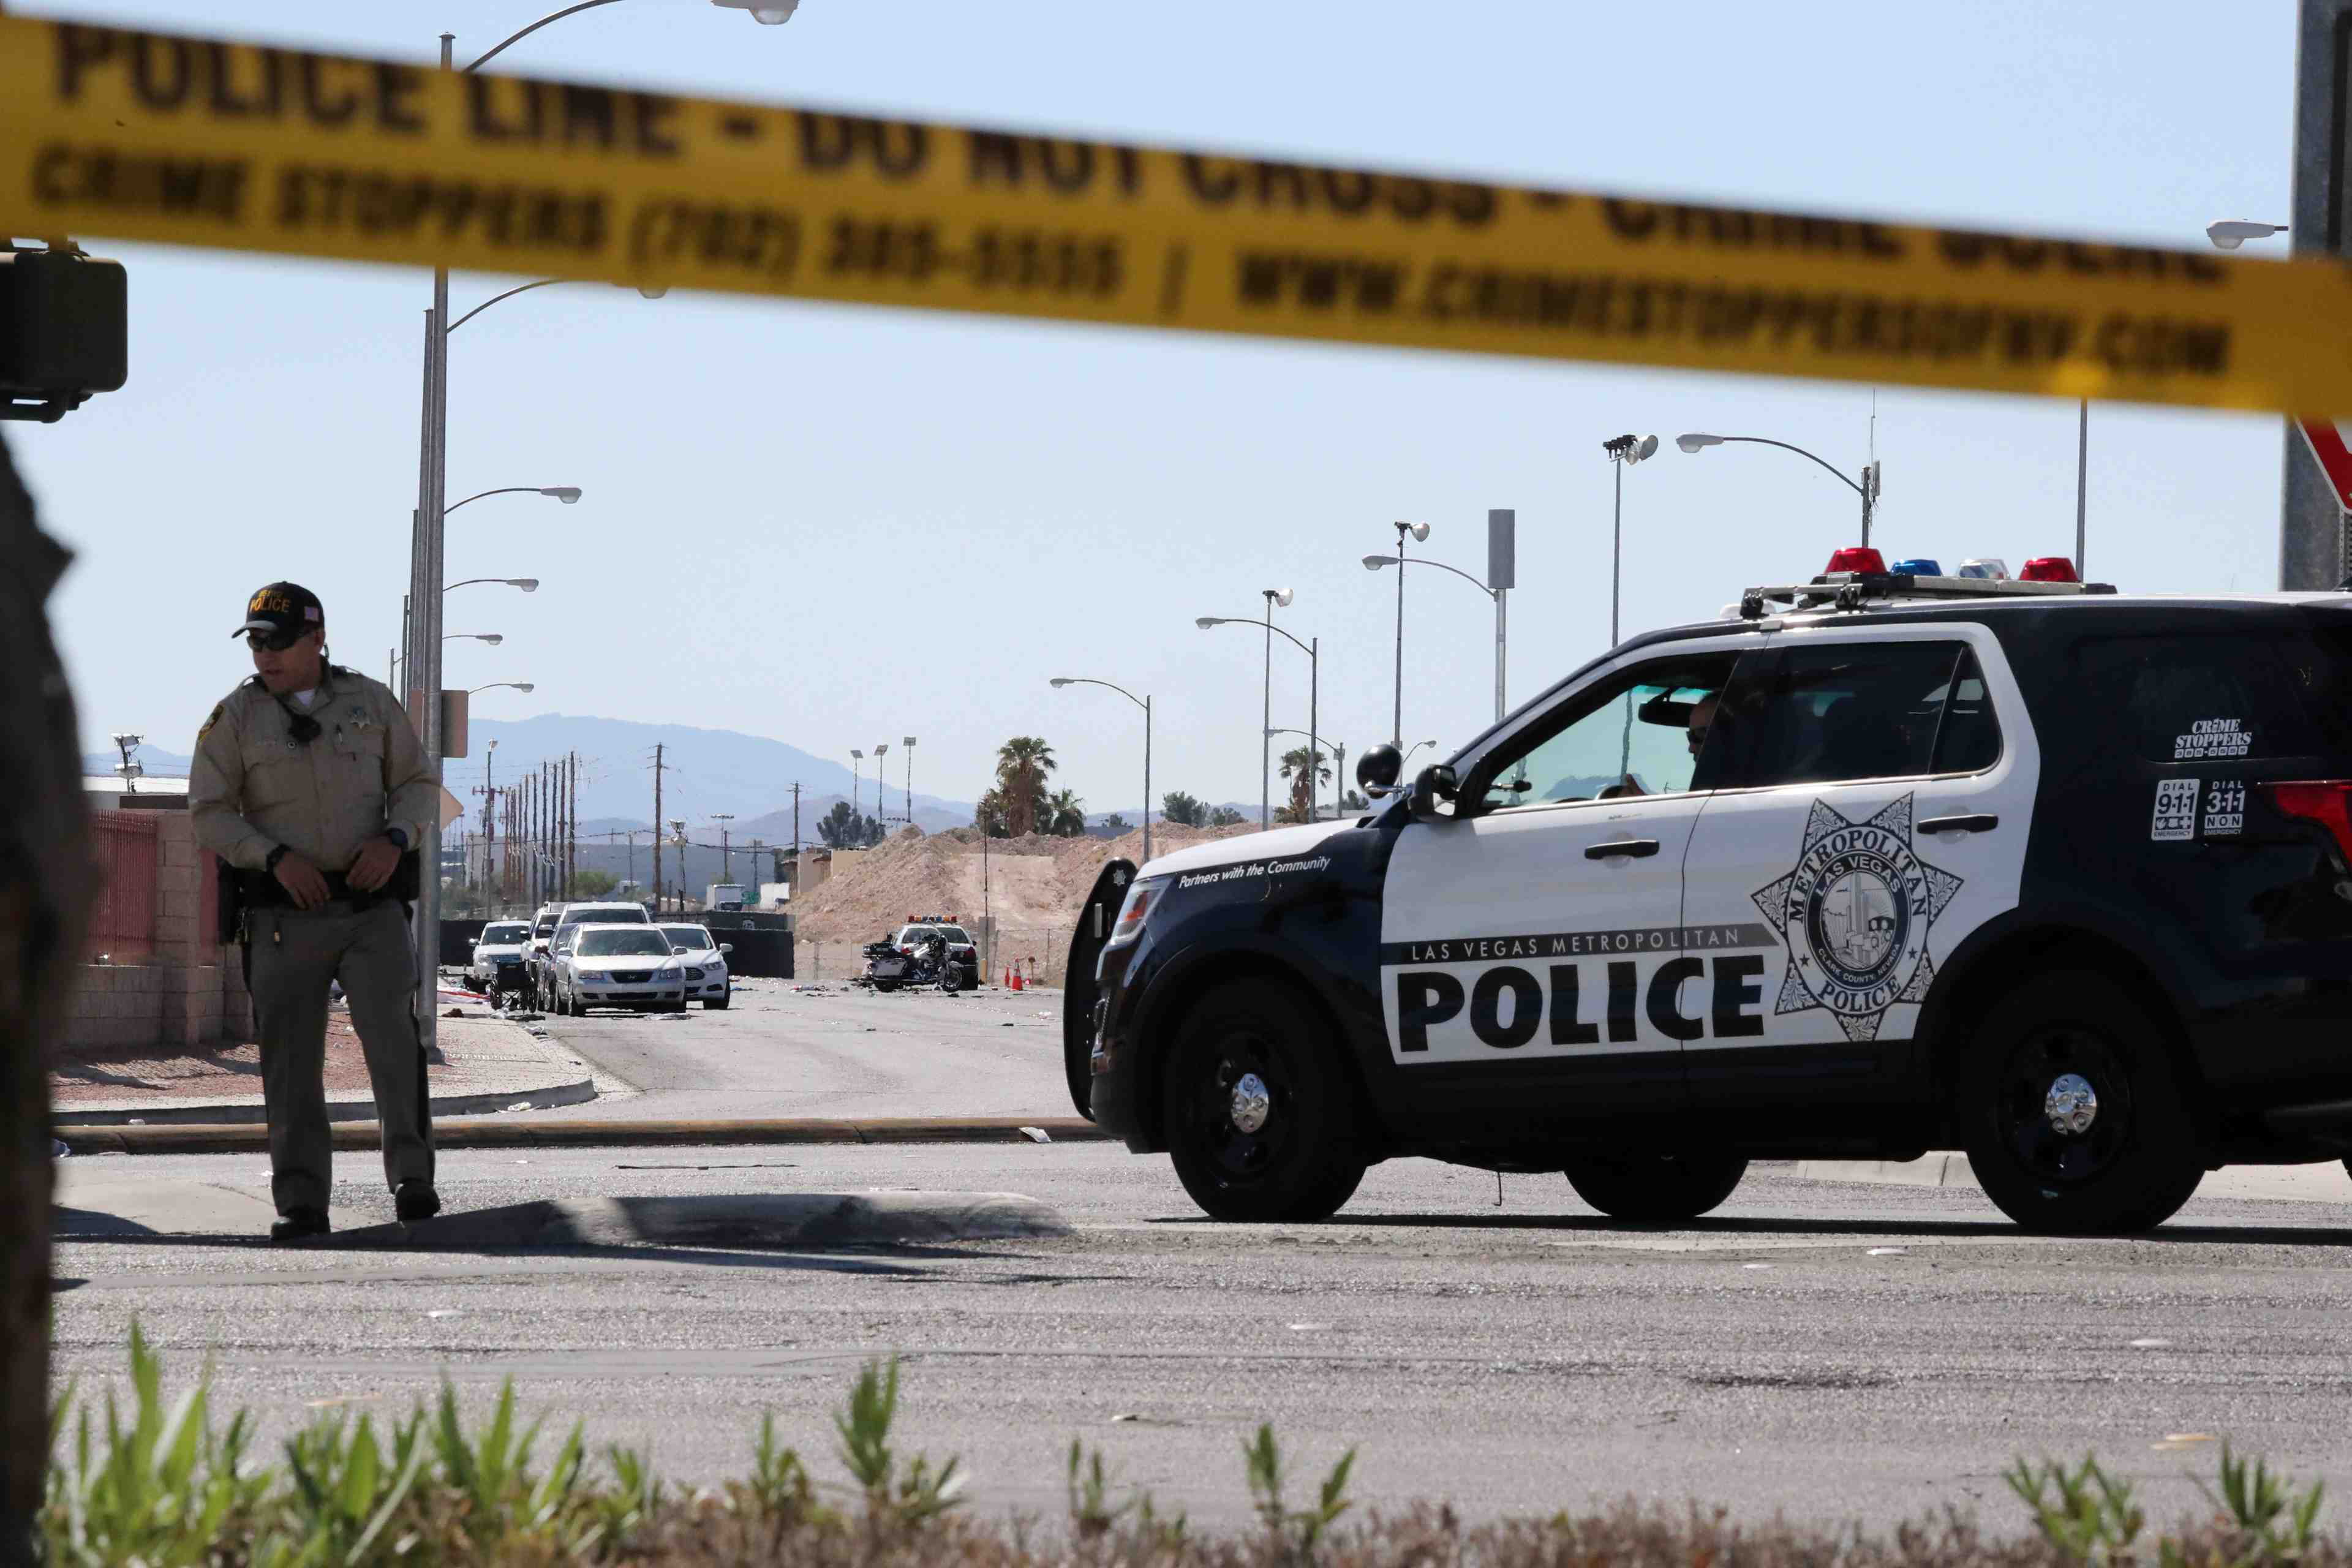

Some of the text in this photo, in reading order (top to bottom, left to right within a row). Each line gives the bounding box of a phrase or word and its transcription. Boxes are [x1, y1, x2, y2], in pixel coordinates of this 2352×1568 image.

[54, 23, 429, 138] POLICE
[467, 72, 681, 158] LINE
[796, 108, 928, 181] DO
[965, 130, 1144, 198] NOT
[31, 141, 247, 225] CRIME
[277, 160, 606, 257] STOPPERS
[249, 597, 290, 613] POLICE
[2176, 732, 2252, 748] STOPPERS
[2212, 780, 2244, 789] DIAL
[2207, 816, 2240, 826] NON
[1178, 856, 1331, 889] Partners with the Community
[1789, 829, 1927, 924] METROPOLITAN
[1816, 856, 1900, 897] LAS VEGAS
[1412, 929, 1740, 960] LAS VEGAS METROPOLITAN
[1818, 948, 1842, 976] CLARK
[1877, 944, 1901, 976] NEVADA
[1397, 954, 1765, 1053] POLICE
[1817, 975, 1902, 1012] POLICE
